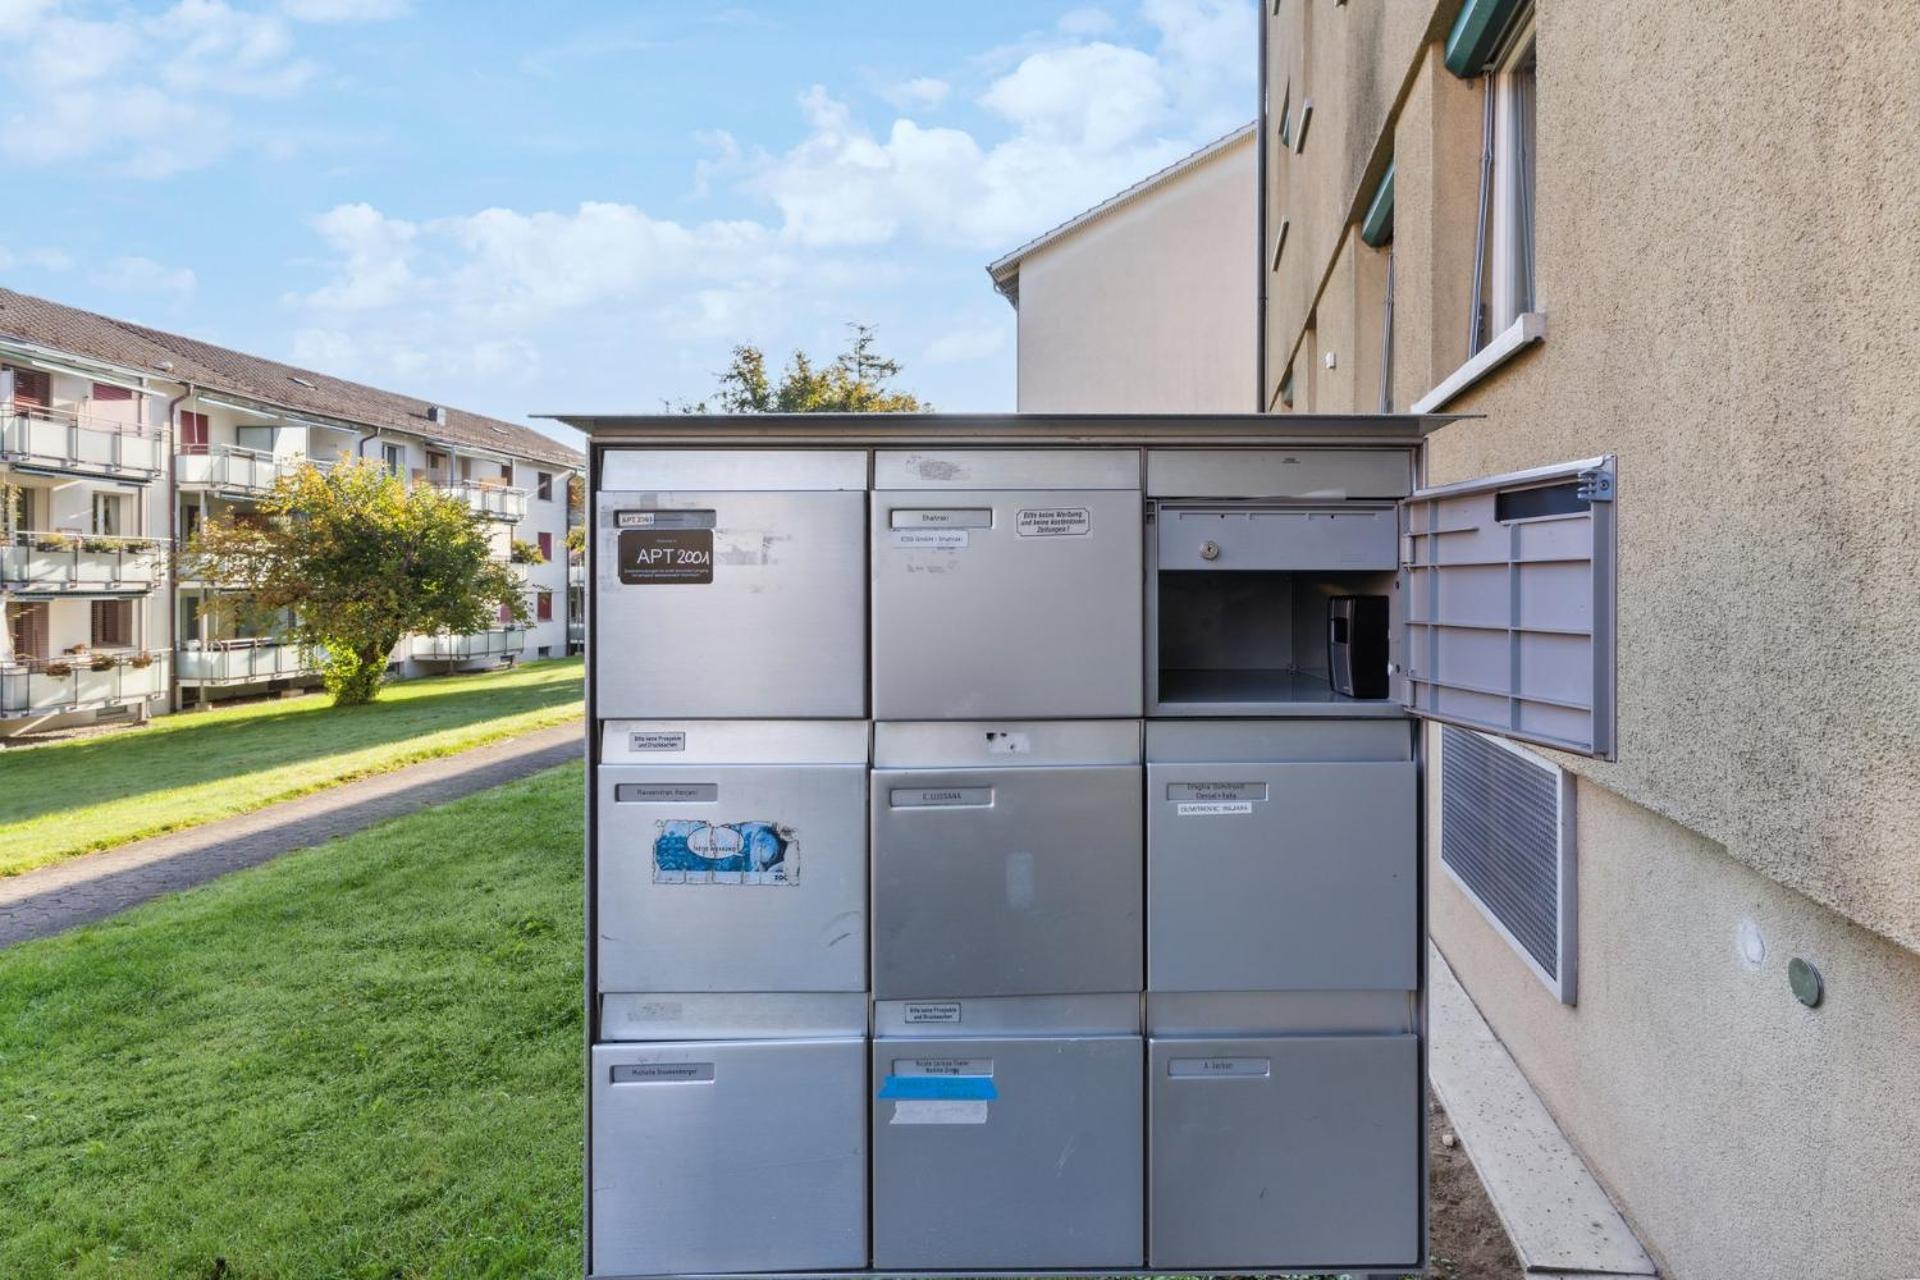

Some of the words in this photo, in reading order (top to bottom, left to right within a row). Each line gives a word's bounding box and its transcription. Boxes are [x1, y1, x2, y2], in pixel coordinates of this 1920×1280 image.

[1023, 511, 1037, 520] Bitte
[1039, 511, 1054, 519] keine
[1056, 511, 1083, 520] Werbung
[636, 548, 675, 564] APT
[677, 549, 710, 565] 2001
